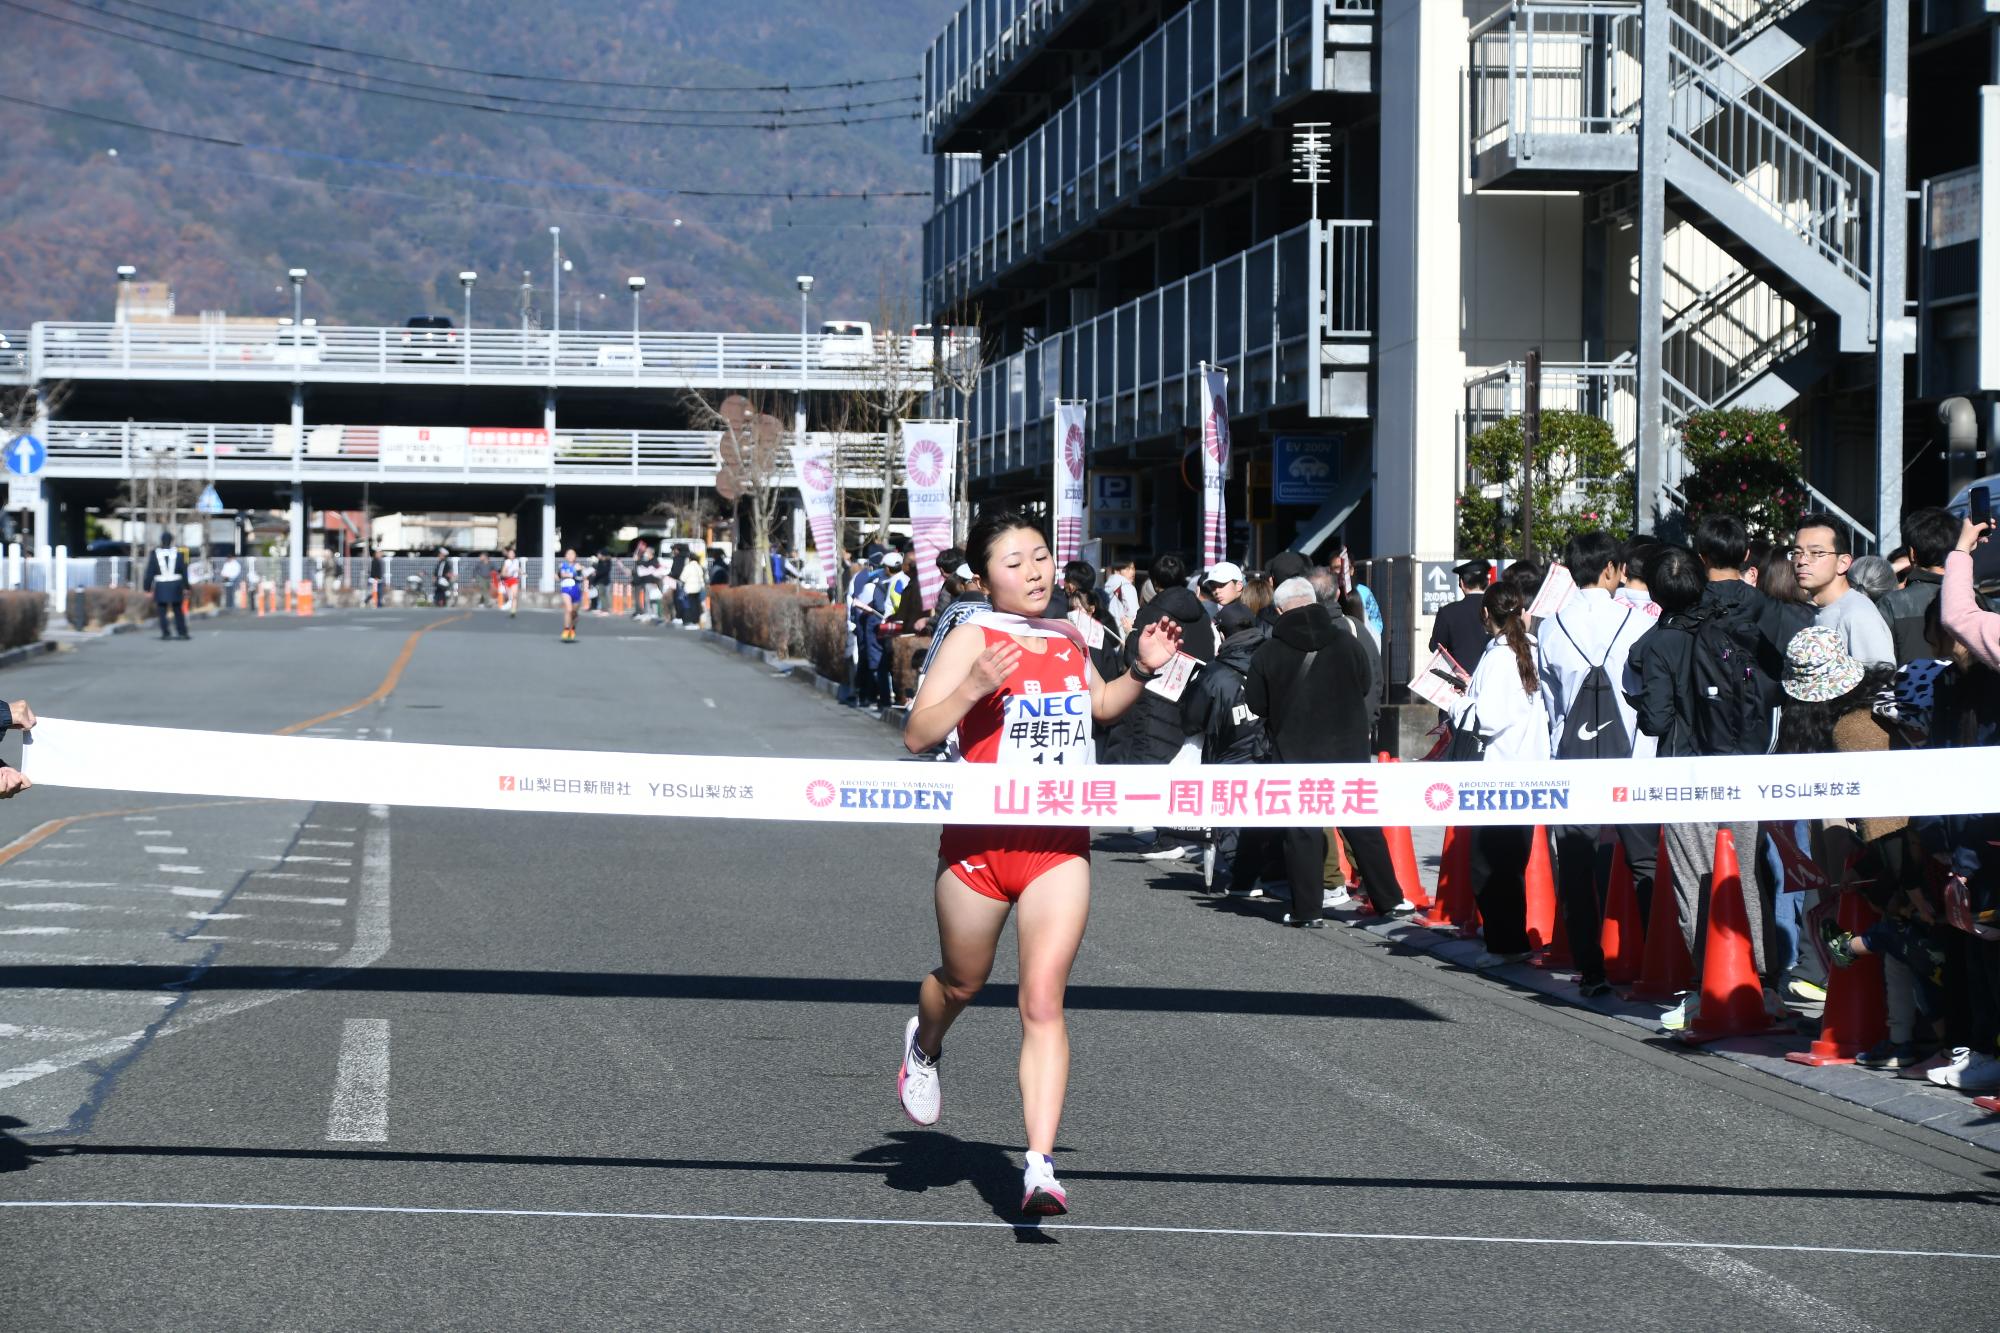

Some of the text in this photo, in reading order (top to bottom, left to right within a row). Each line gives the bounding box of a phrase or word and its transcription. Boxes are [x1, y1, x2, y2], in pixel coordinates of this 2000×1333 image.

[1103, 478, 1128, 497] P
[1100, 500, 1131, 509] 入口
[1019, 694, 1083, 719] NEC
[1009, 719, 1087, 748] 甲斐市A
[519, 777, 754, 799] 山梨日日新聞社 YBS山梨放送
[881, 780, 898, 788] THE
[902, 781, 954, 789] YAMANASHI
[1520, 780, 1571, 788] YAMANASHI
[1632, 781, 1861, 802] 山梨日日新聞社 YBS山梨放送
[839, 787, 954, 811] EKIDEN
[994, 778, 1379, 816] 山梨県一周駅伝競走
[1458, 788, 1570, 811] EKIDEN
